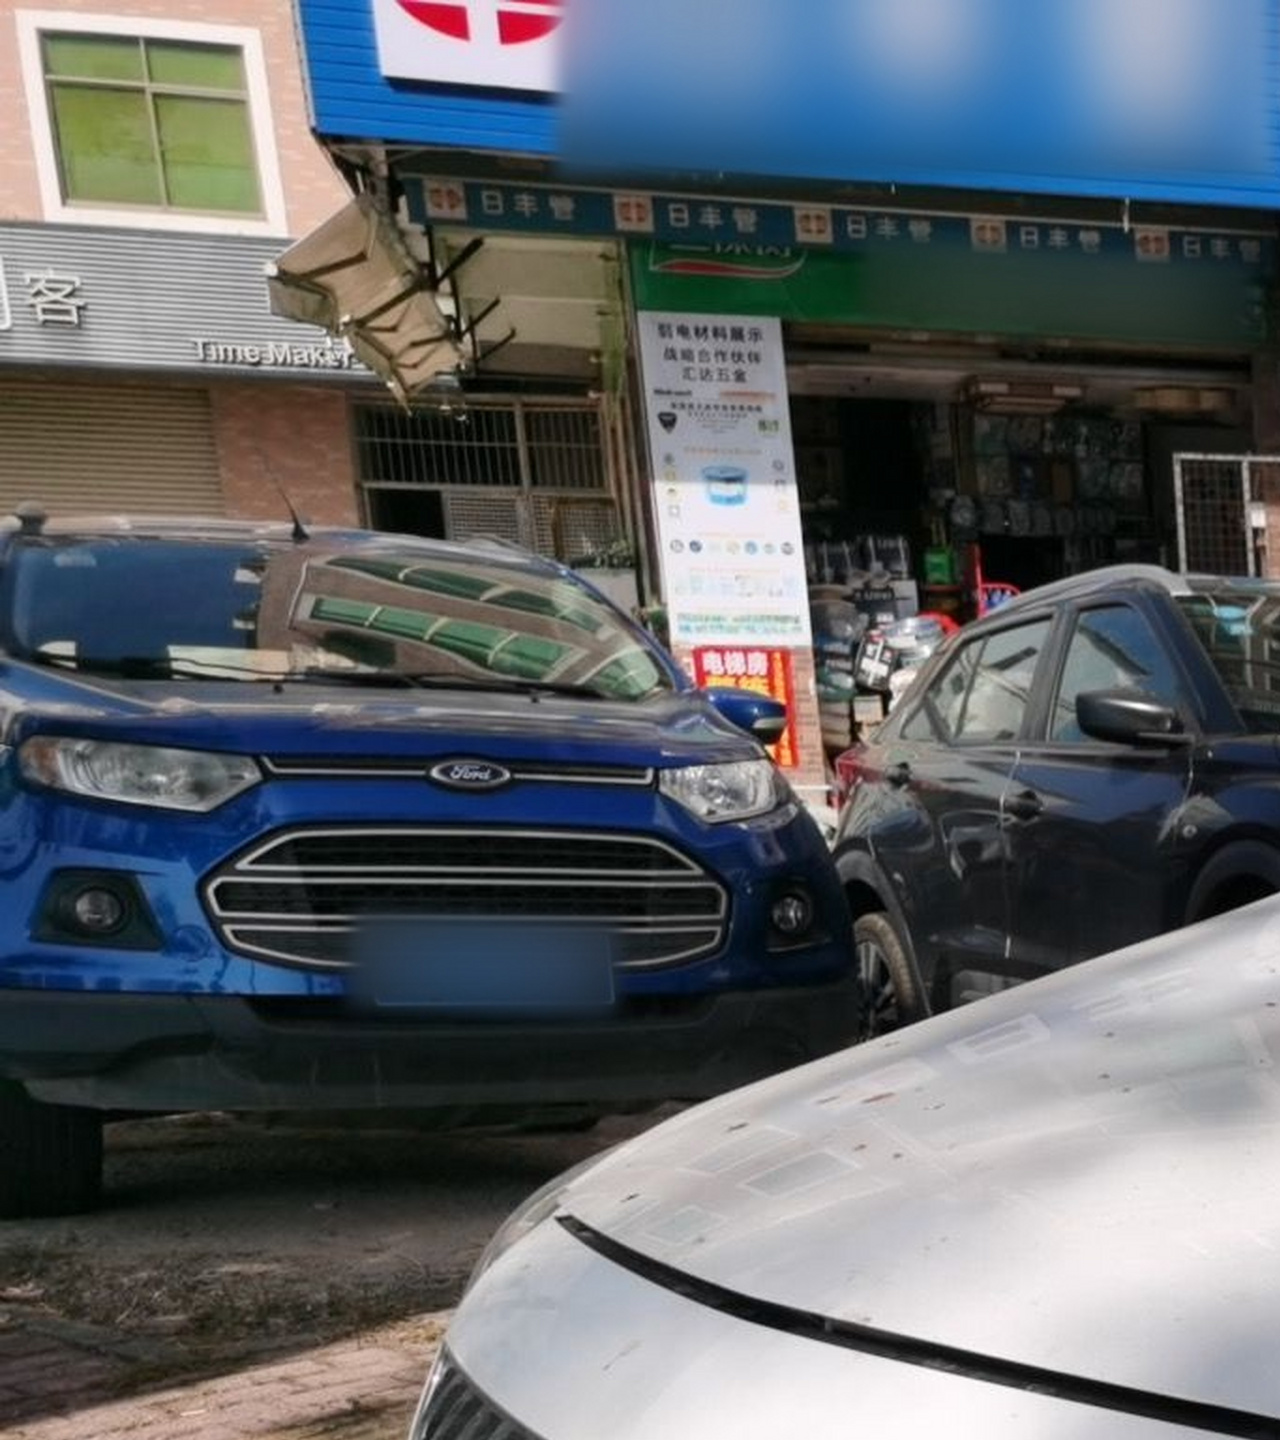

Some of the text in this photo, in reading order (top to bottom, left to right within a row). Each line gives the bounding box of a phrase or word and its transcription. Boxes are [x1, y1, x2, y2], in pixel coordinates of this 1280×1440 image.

[481, 189, 575, 221] 日丰管
[668, 203, 758, 233] 日丰管
[196, 338, 262, 364] Time
[663, 346, 762, 364] 战略合作伙伴
[701, 650, 769, 676] 电梯房
[449, 764, 492, 781] Ford
